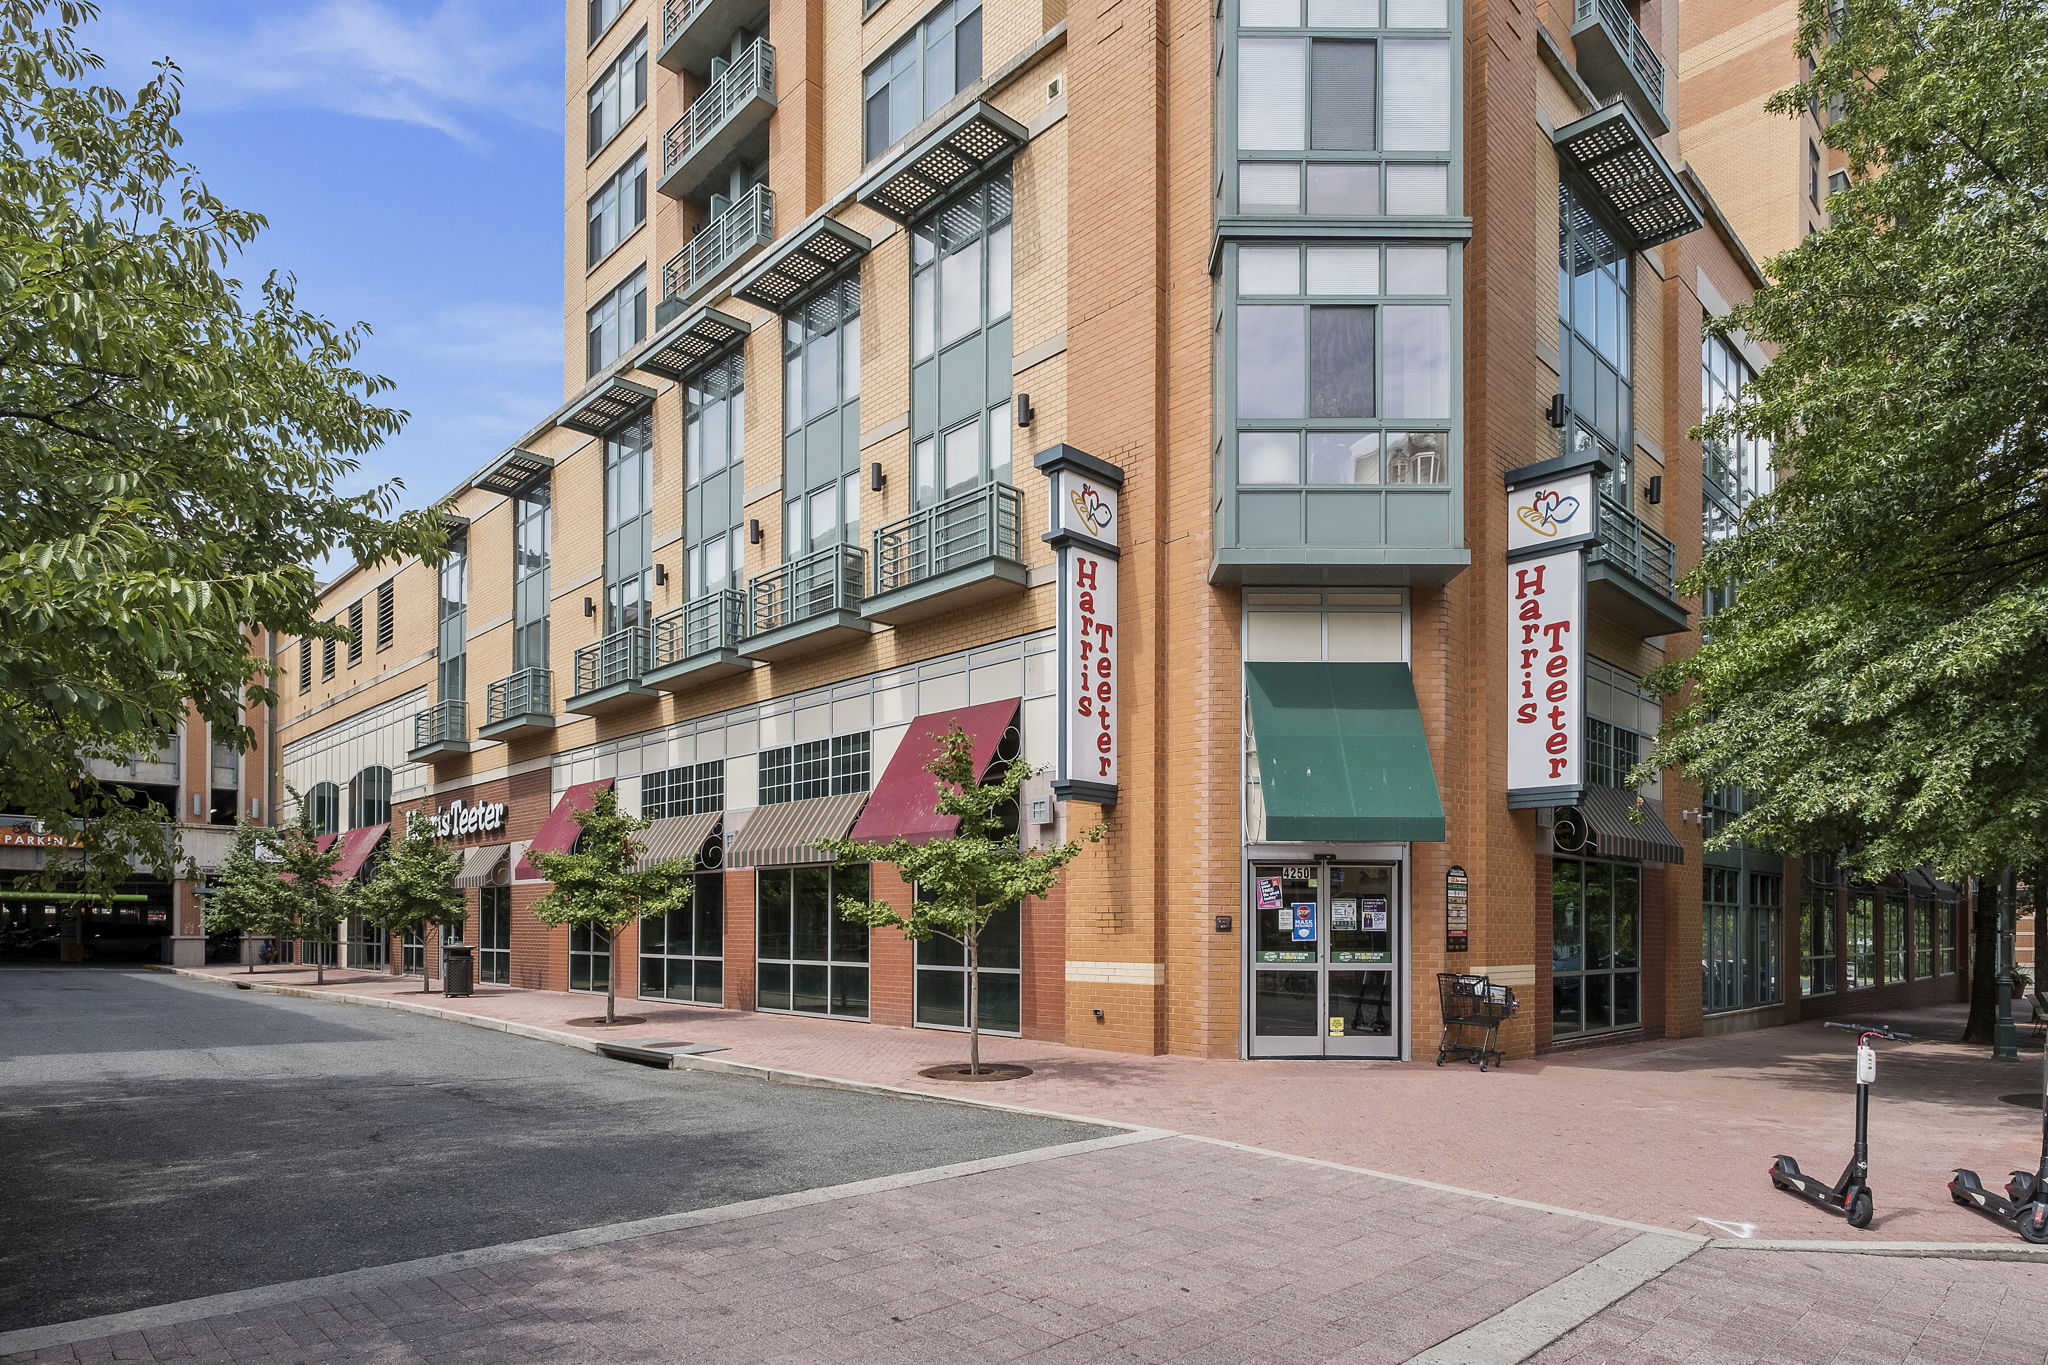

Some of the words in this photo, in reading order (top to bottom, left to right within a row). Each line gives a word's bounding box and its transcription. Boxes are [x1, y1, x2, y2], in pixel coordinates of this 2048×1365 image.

[1077, 557, 1098, 718] Harris
[1095, 622, 1113, 777] Teeter
[1515, 564, 1547, 724] Harris
[1543, 620, 1571, 779] Teeter
[450, 799, 504, 835] Teeter
[4, 834, 77, 847] PARKIN
[1284, 867, 1309, 878] 4250
